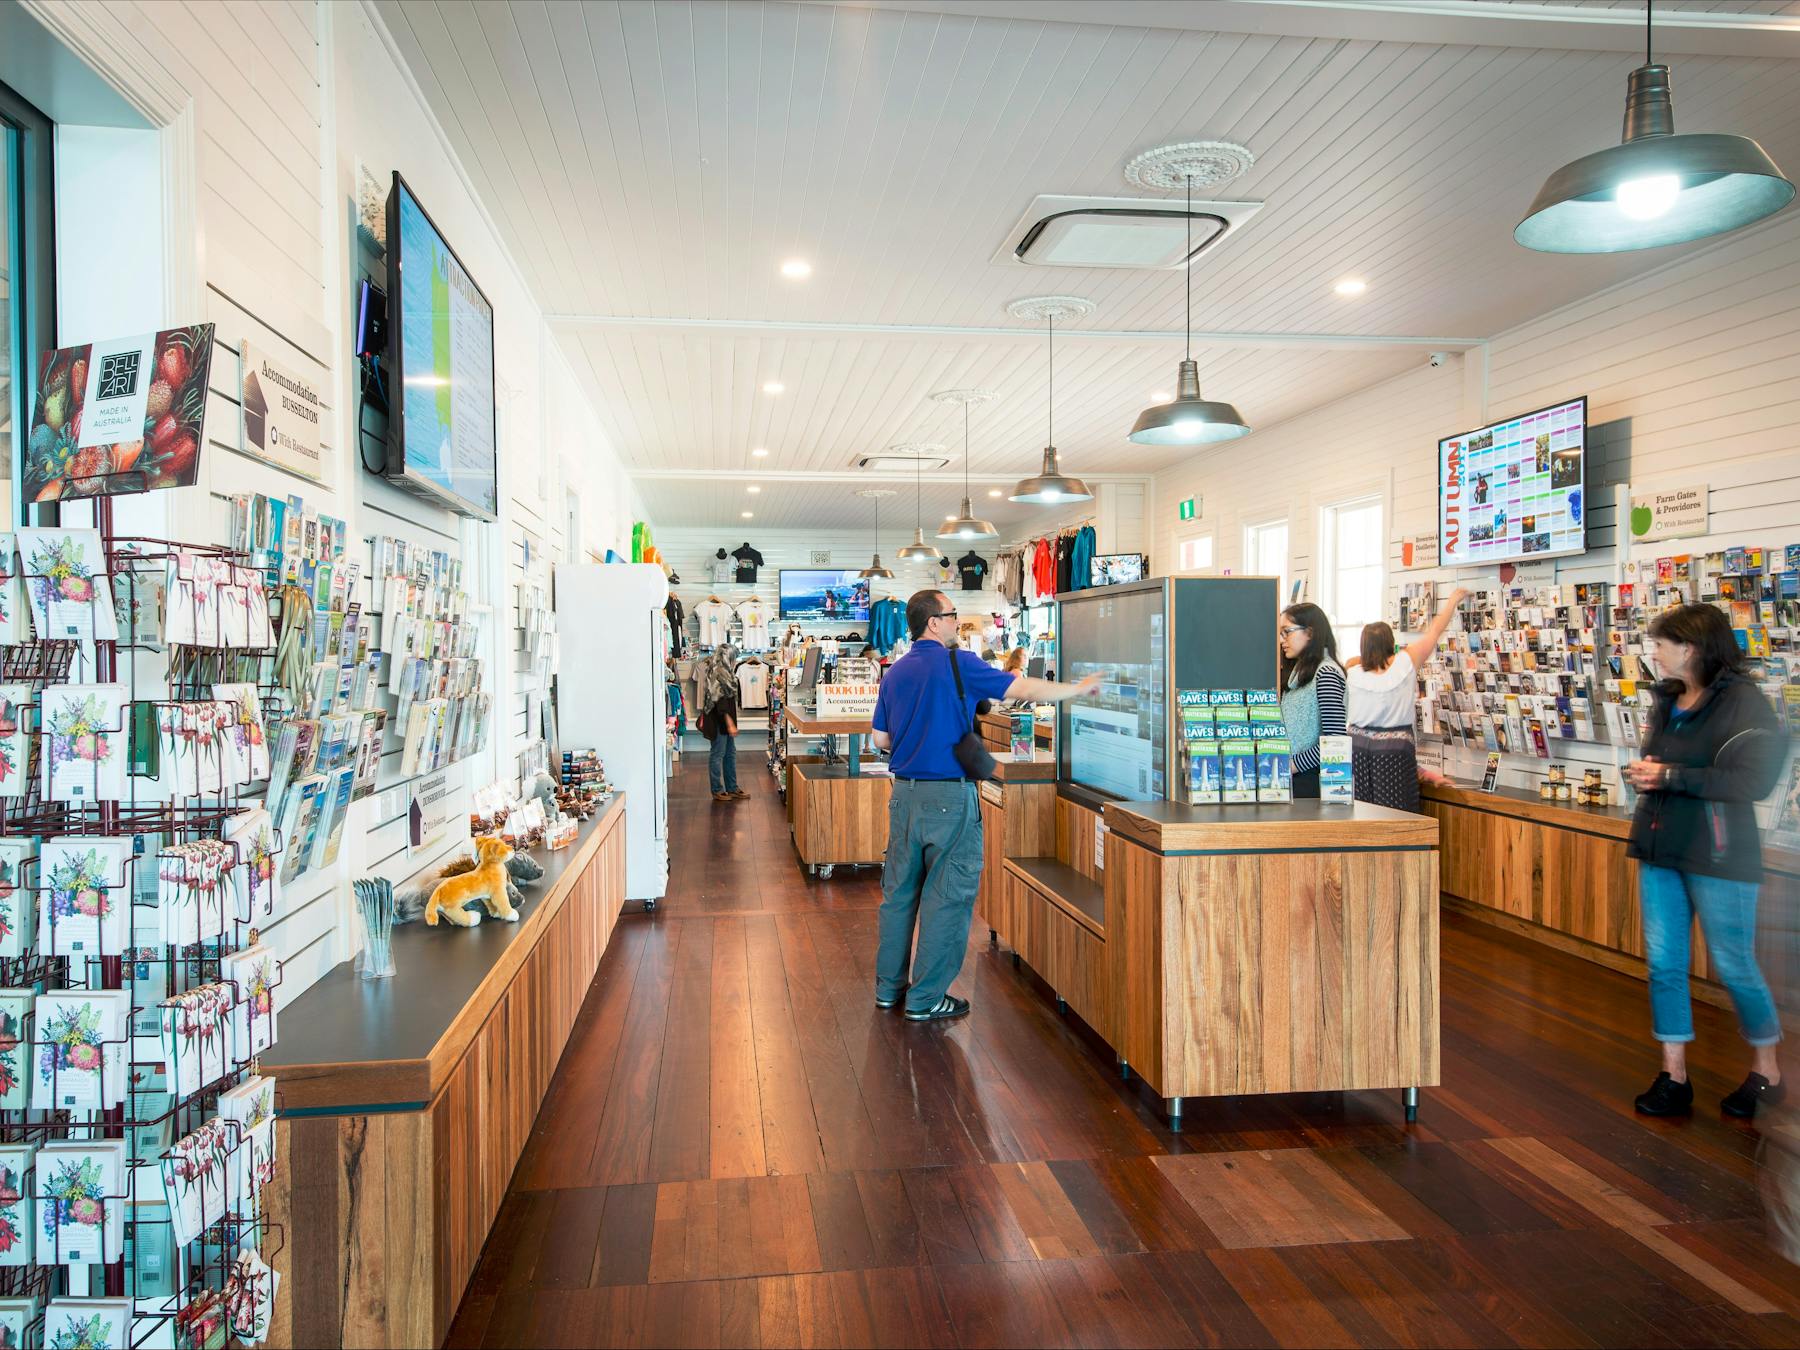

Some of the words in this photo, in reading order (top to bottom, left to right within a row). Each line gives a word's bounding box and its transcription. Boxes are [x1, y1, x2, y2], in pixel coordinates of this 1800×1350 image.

[102, 356, 138, 382] BELL
[101, 370, 137, 397] ART
[261, 360, 318, 405] Accommodation
[100, 406, 120, 416] MADE
[122, 405, 129, 413] IN
[282, 395, 318, 424] BUSSELTON
[94, 416, 132, 427] AUSTRALIA
[1445, 442, 1461, 554] AUTUMN
[1656, 495, 1676, 504] Farm
[1676, 491, 1697, 502] Gates
[1663, 502, 1701, 514] Providores
[825, 686, 852, 695] BOOK
[1180, 693, 1208, 703] CAVES
[1211, 693, 1239, 703] CAVES
[1247, 693, 1274, 703] CAVES
[1185, 727, 1214, 737] CAVES
[1222, 727, 1250, 737] CAVES
[1258, 726, 1286, 737] CAVES
